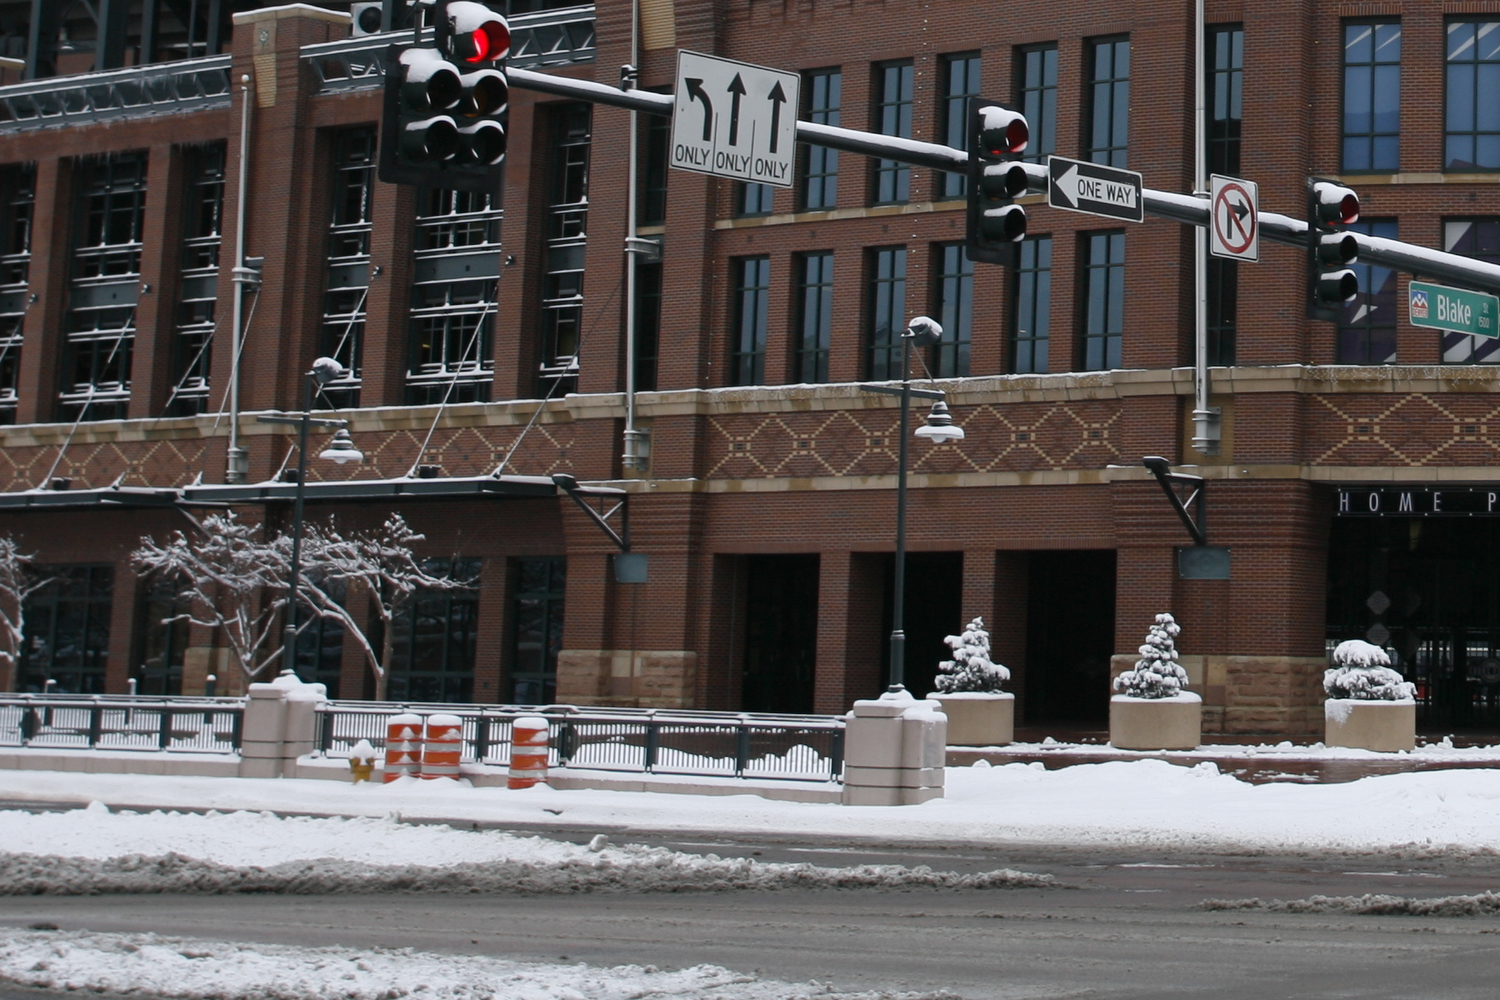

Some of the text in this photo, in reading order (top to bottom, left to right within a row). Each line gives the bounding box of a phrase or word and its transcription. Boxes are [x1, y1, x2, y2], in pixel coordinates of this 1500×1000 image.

[675, 144, 711, 166] ONLY
[716, 151, 751, 173] ONLY
[755, 158, 789, 179] ONLY
[1077, 179, 1132, 204] ONE WAY
[1437, 294, 1471, 325] Blake
[1339, 492, 1442, 512] HOME
